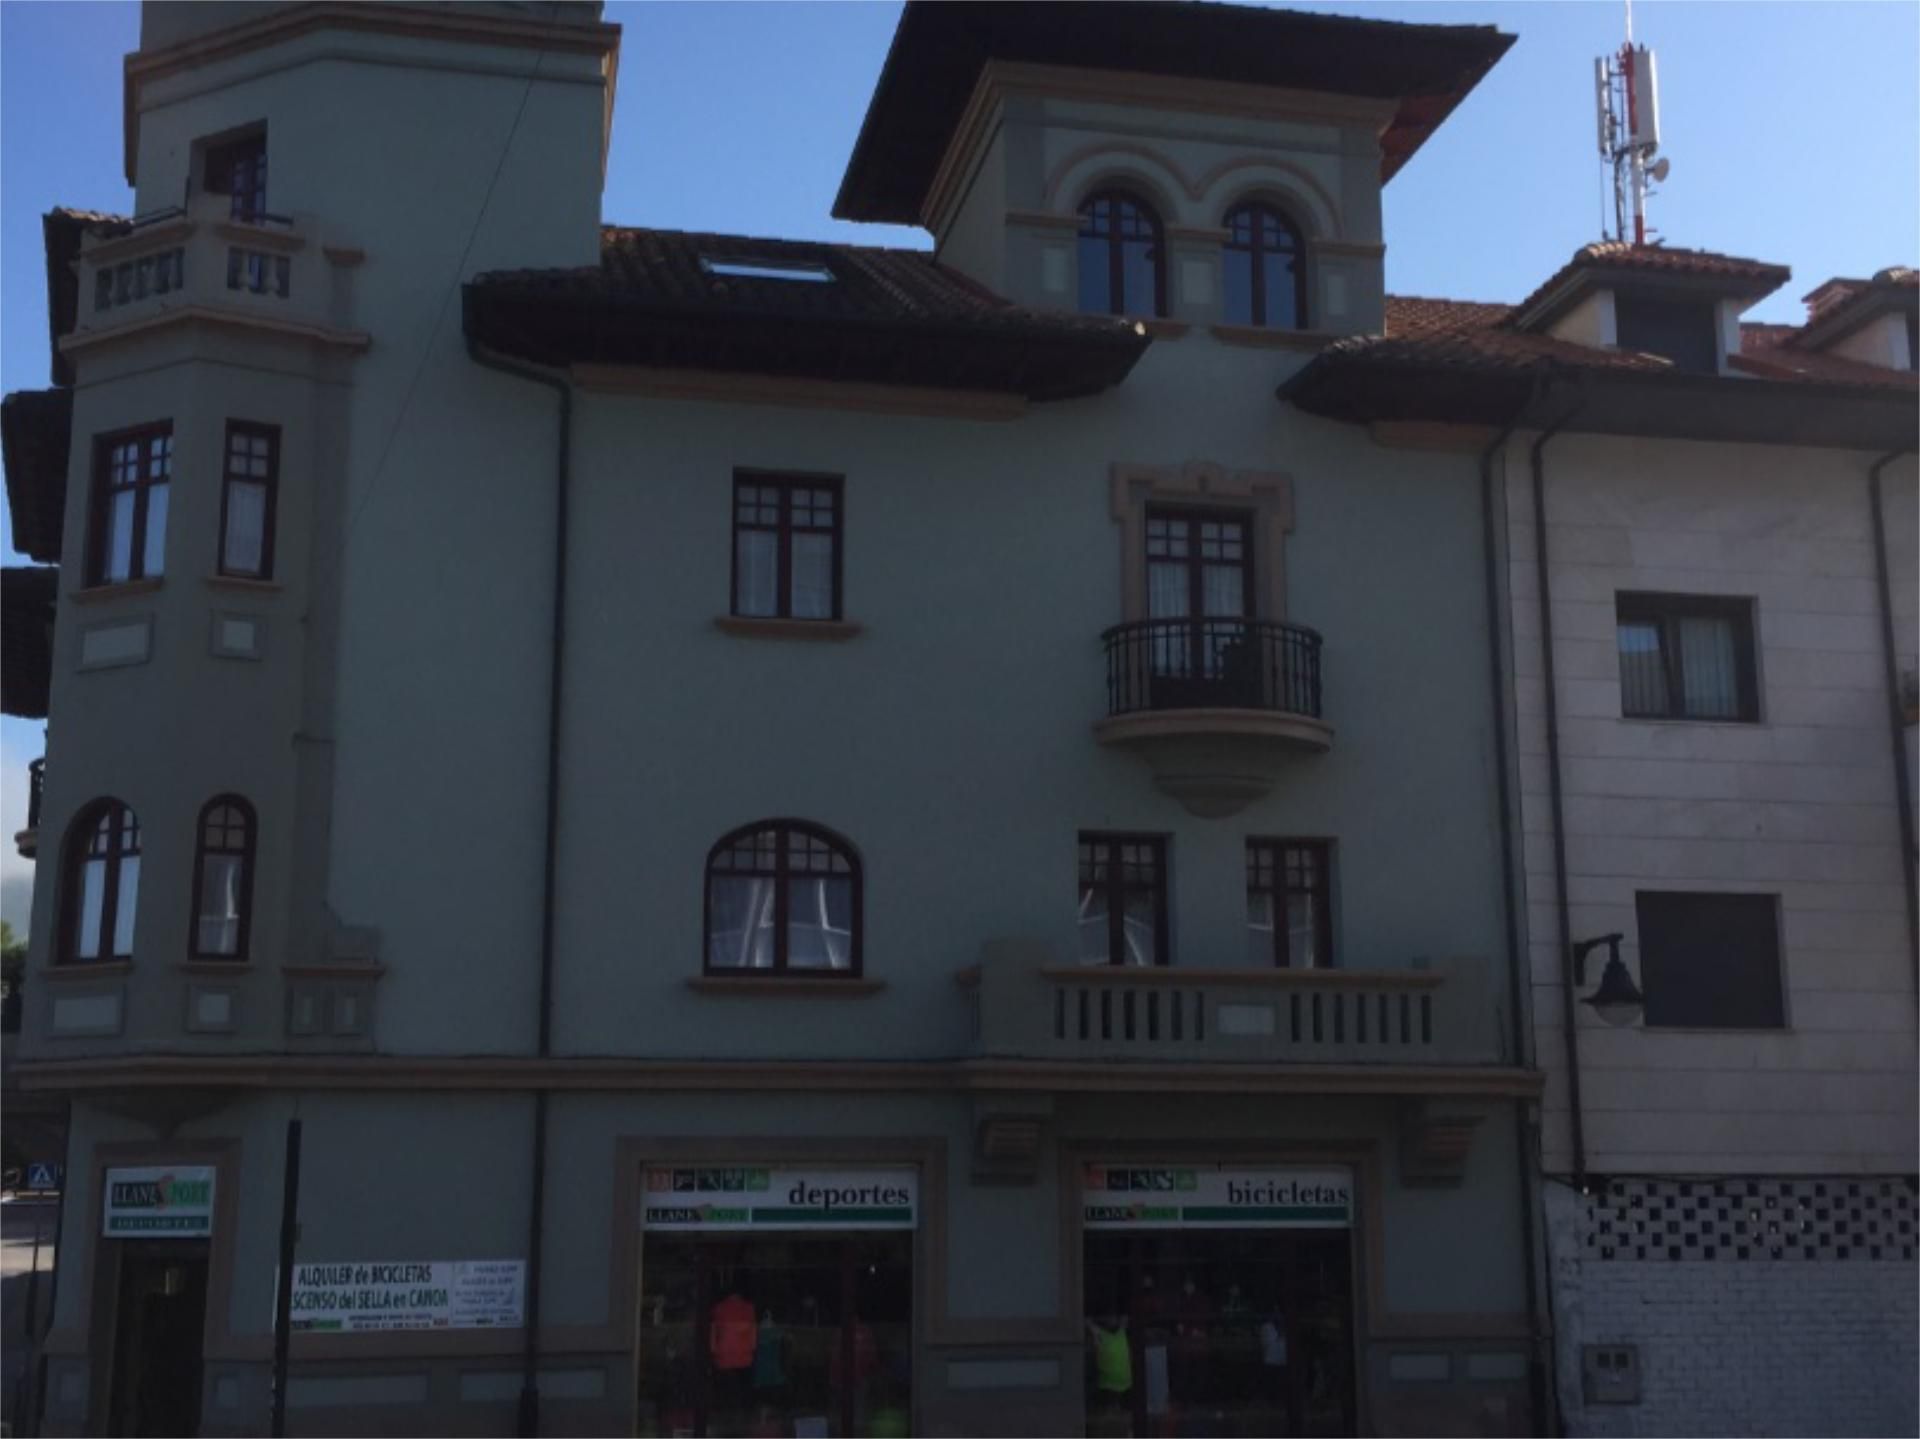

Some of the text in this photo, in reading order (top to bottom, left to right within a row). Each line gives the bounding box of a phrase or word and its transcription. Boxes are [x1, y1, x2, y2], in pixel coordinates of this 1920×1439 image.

[788, 1180, 910, 1211] deportes
[1227, 1181, 1349, 1205] bicicletas
[298, 1264, 432, 1287] ALQUILER de BICICLETAS
[291, 1290, 337, 1311] SCENSO
[339, 1290, 356, 1309] del
[358, 1289, 391, 1309] SELLA
[393, 1293, 406, 1308] en
[409, 1288, 448, 1307] CANOA
